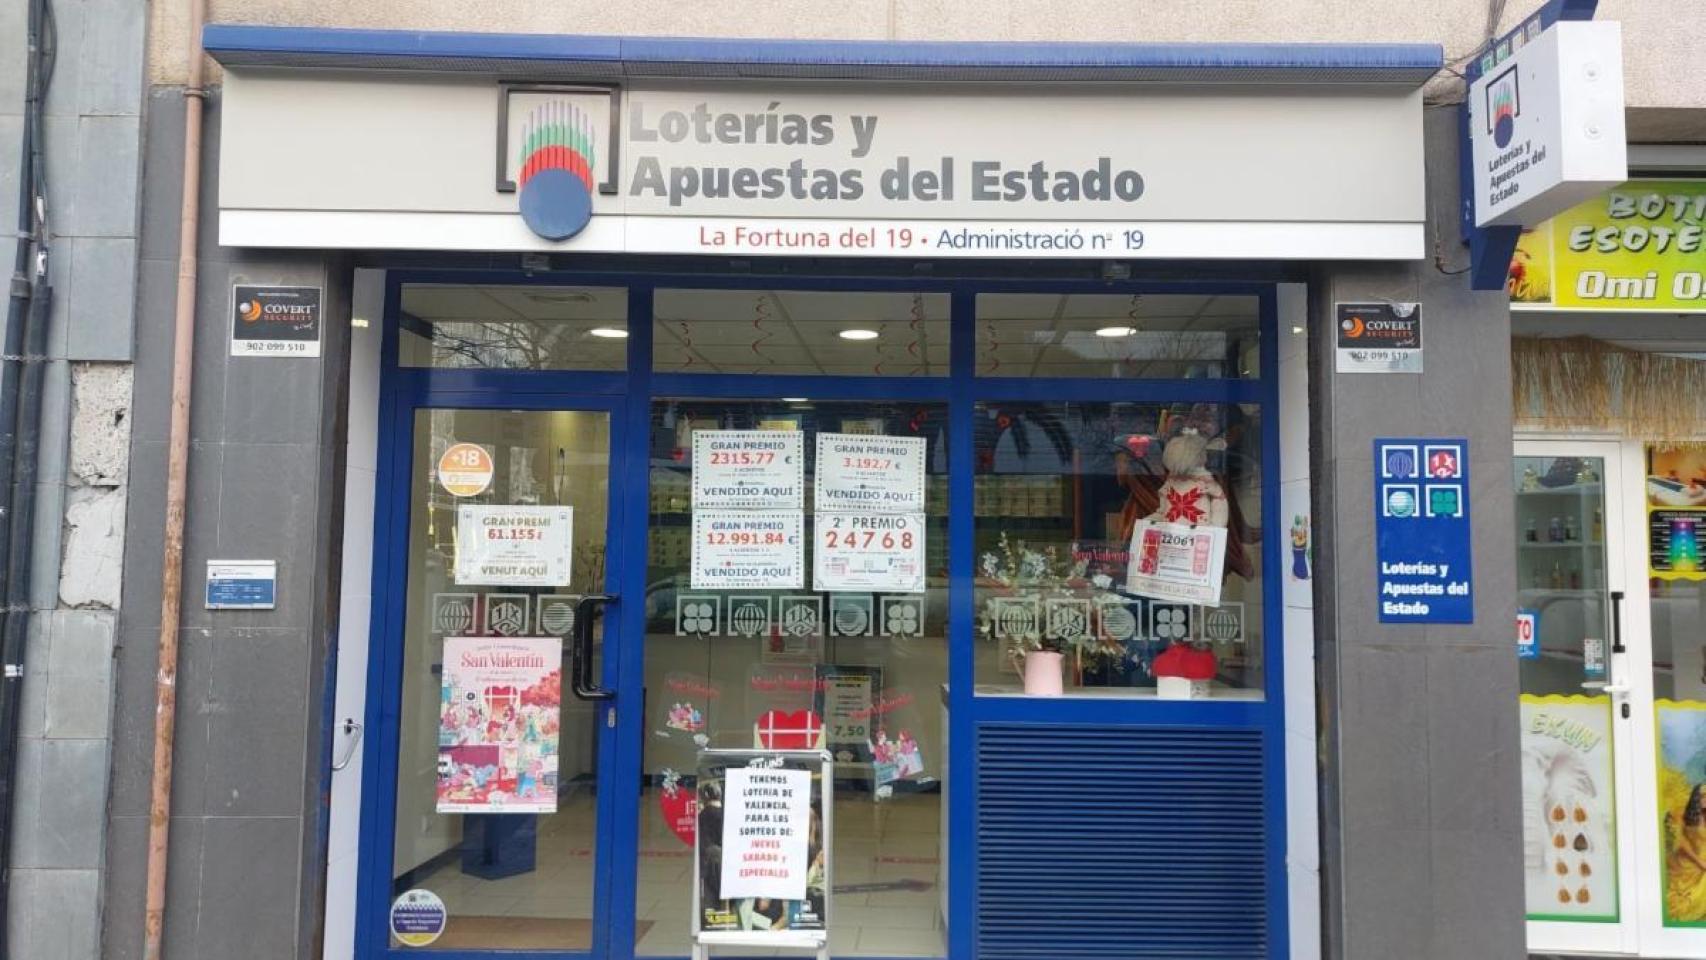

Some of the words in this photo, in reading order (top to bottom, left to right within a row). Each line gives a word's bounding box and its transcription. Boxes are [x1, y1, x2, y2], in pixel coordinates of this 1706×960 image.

[629, 102, 835, 145] Loterías
[851, 115, 877, 157] y
[1489, 158, 1530, 191] Apuestas
[1532, 144, 1546, 165] del
[629, 157, 866, 206] Apuestas
[880, 157, 953, 201] del
[971, 158, 1145, 202] Estado
[1489, 182, 1519, 206] Estado
[700, 226, 726, 246] La
[735, 227, 830, 248] Fortuna
[839, 227, 876, 249] del
[886, 228, 913, 248] 19
[936, 228, 1084, 250] Administració
[1123, 229, 1144, 250] 19
[1576, 271, 1657, 299] Omi
[264, 304, 312, 314] COVERT
[1366, 320, 1412, 331] COVERT
[246, 342, 264, 351] 902
[711, 441, 740, 450] GRAN
[744, 441, 786, 450] PREMIO
[834, 444, 864, 454] GRAN
[866, 446, 908, 456] PREMIO
[711, 452, 775, 465] 2315.77
[703, 487, 759, 496] VENDIDO
[825, 488, 880, 500] VENDIDO
[482, 517, 515, 527] GRAN
[712, 521, 741, 530] GRAN
[745, 521, 784, 530] PREMIO
[852, 516, 907, 529] PREMIO
[487, 528, 534, 540] 61.155
[706, 532, 784, 545] 12.991.84
[481, 566, 519, 576] VENUT
[703, 567, 759, 577] VENDIDO
[1382, 561, 1437, 575] Loterías
[1440, 563, 1449, 578] y
[1383, 581, 1444, 598] Apuestas
[1447, 581, 1469, 596] del
[1383, 601, 1430, 615] Estado
[461, 650, 488, 668] San
[490, 652, 545, 668] Valentín
[749, 775, 787, 784] TENEMOS
[782, 789, 793, 798] DE
[745, 814, 770, 823] PARA
[773, 815, 789, 823] LOS
[739, 827, 776, 836] SORTEOS
[751, 840, 780, 848] JUEVES
[739, 868, 790, 878] ESPECIALES
